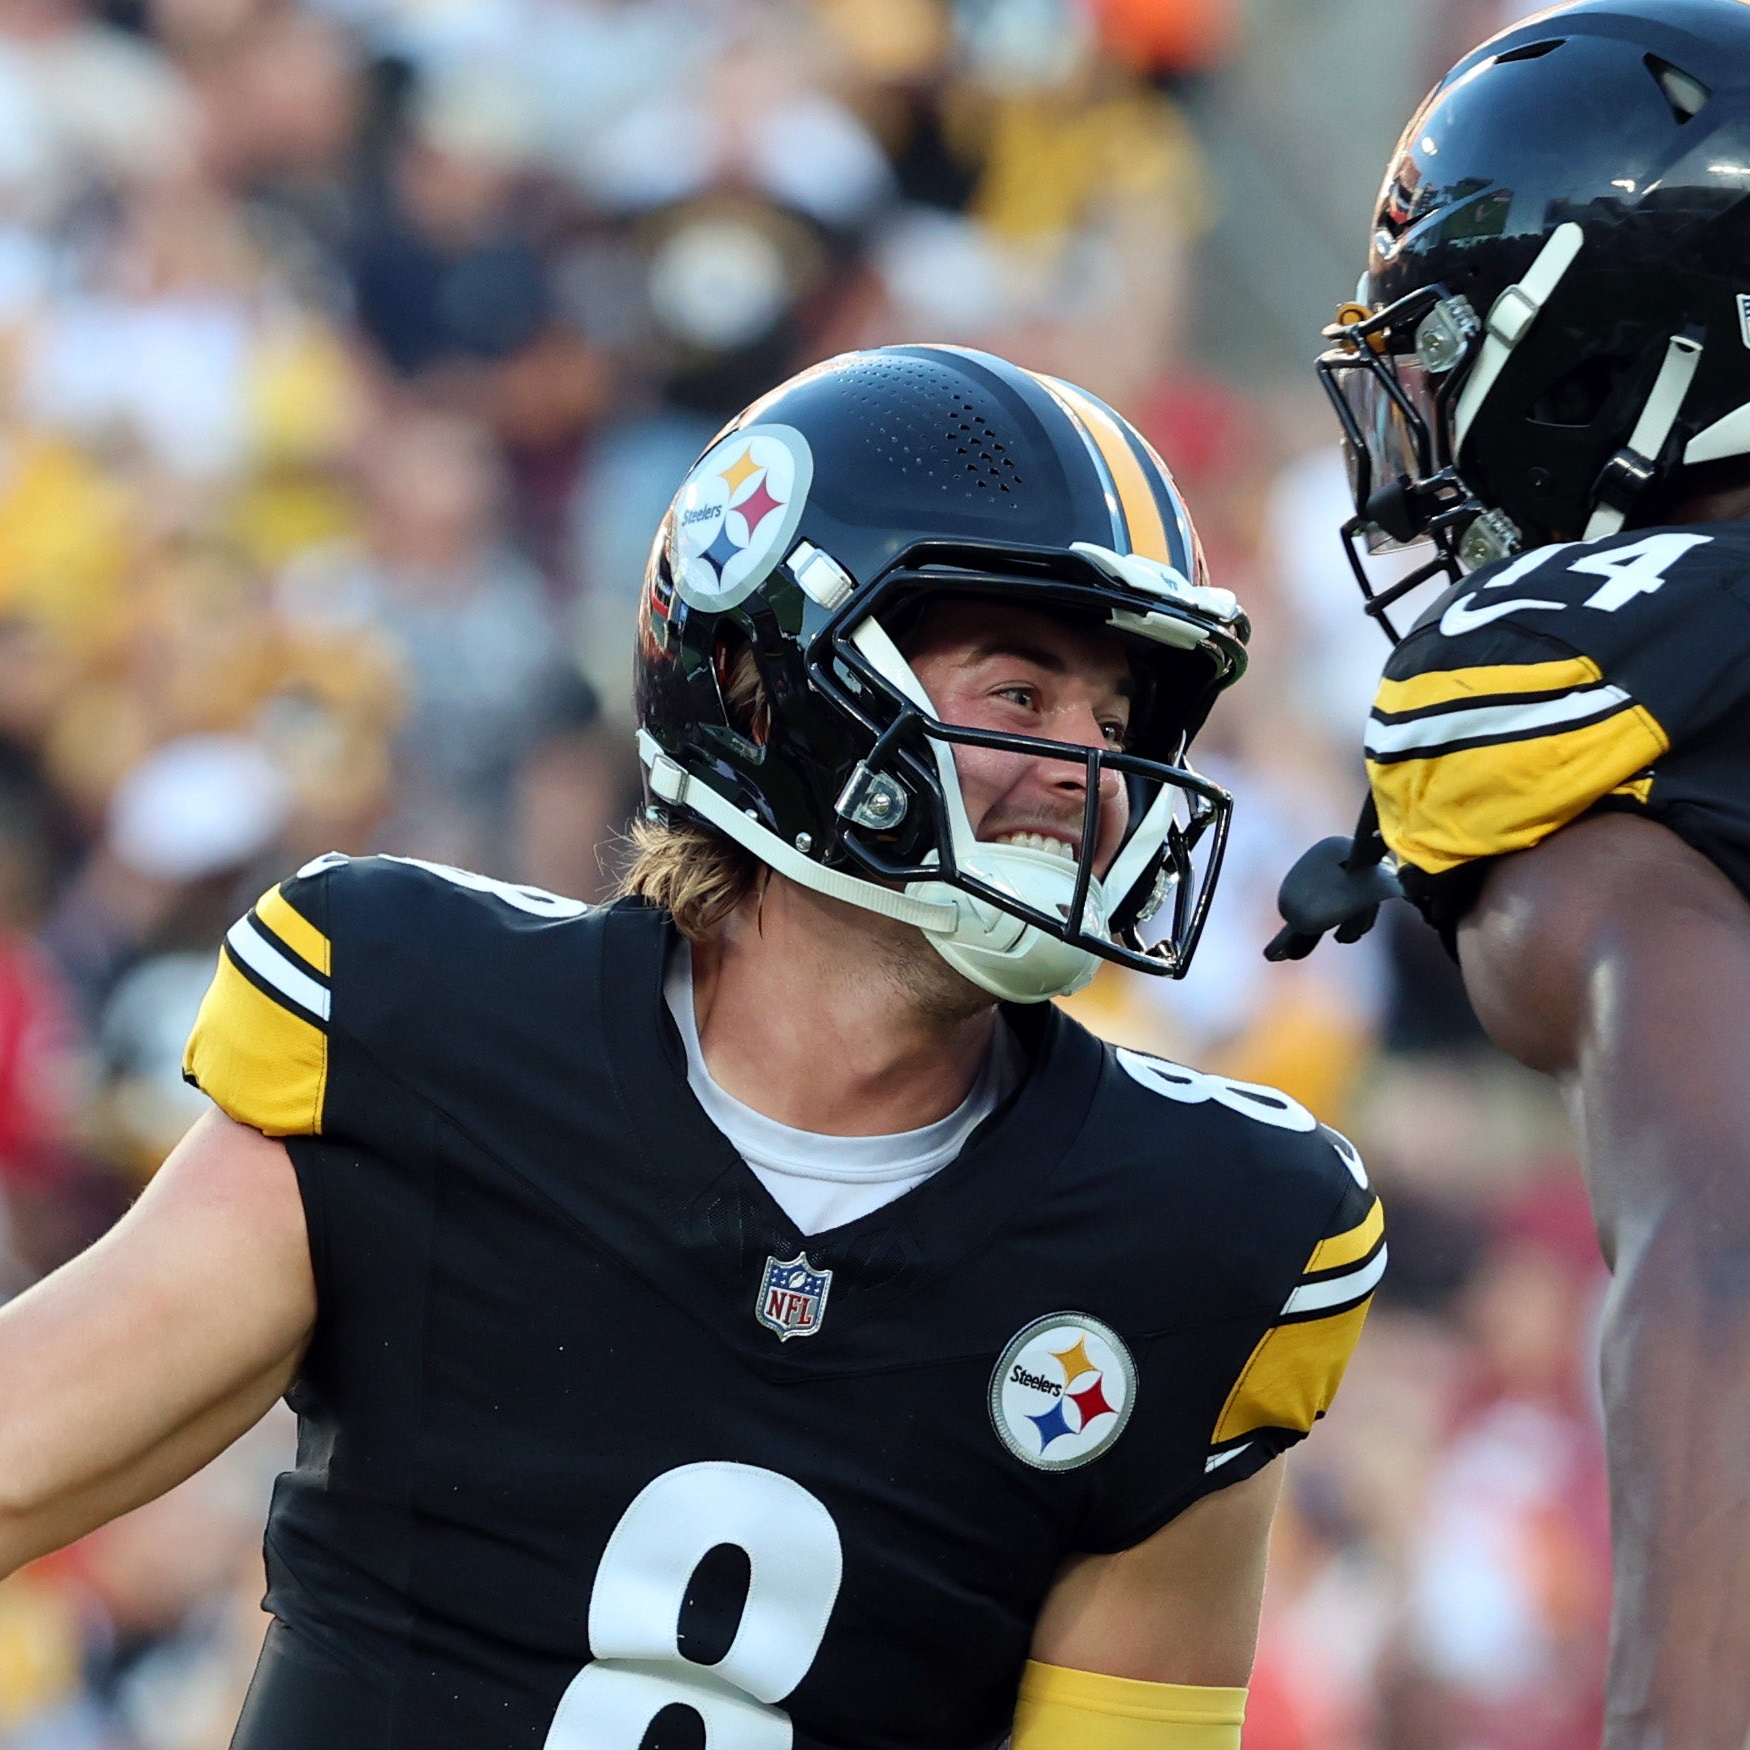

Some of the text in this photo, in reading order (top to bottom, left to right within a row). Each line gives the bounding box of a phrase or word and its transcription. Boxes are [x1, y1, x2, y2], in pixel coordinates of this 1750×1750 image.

[681, 503, 723, 527] Steelers
[1115, 1046, 1317, 1133] 8
[765, 1289, 813, 1326] NFL
[1009, 1364, 1063, 1398] Steelers
